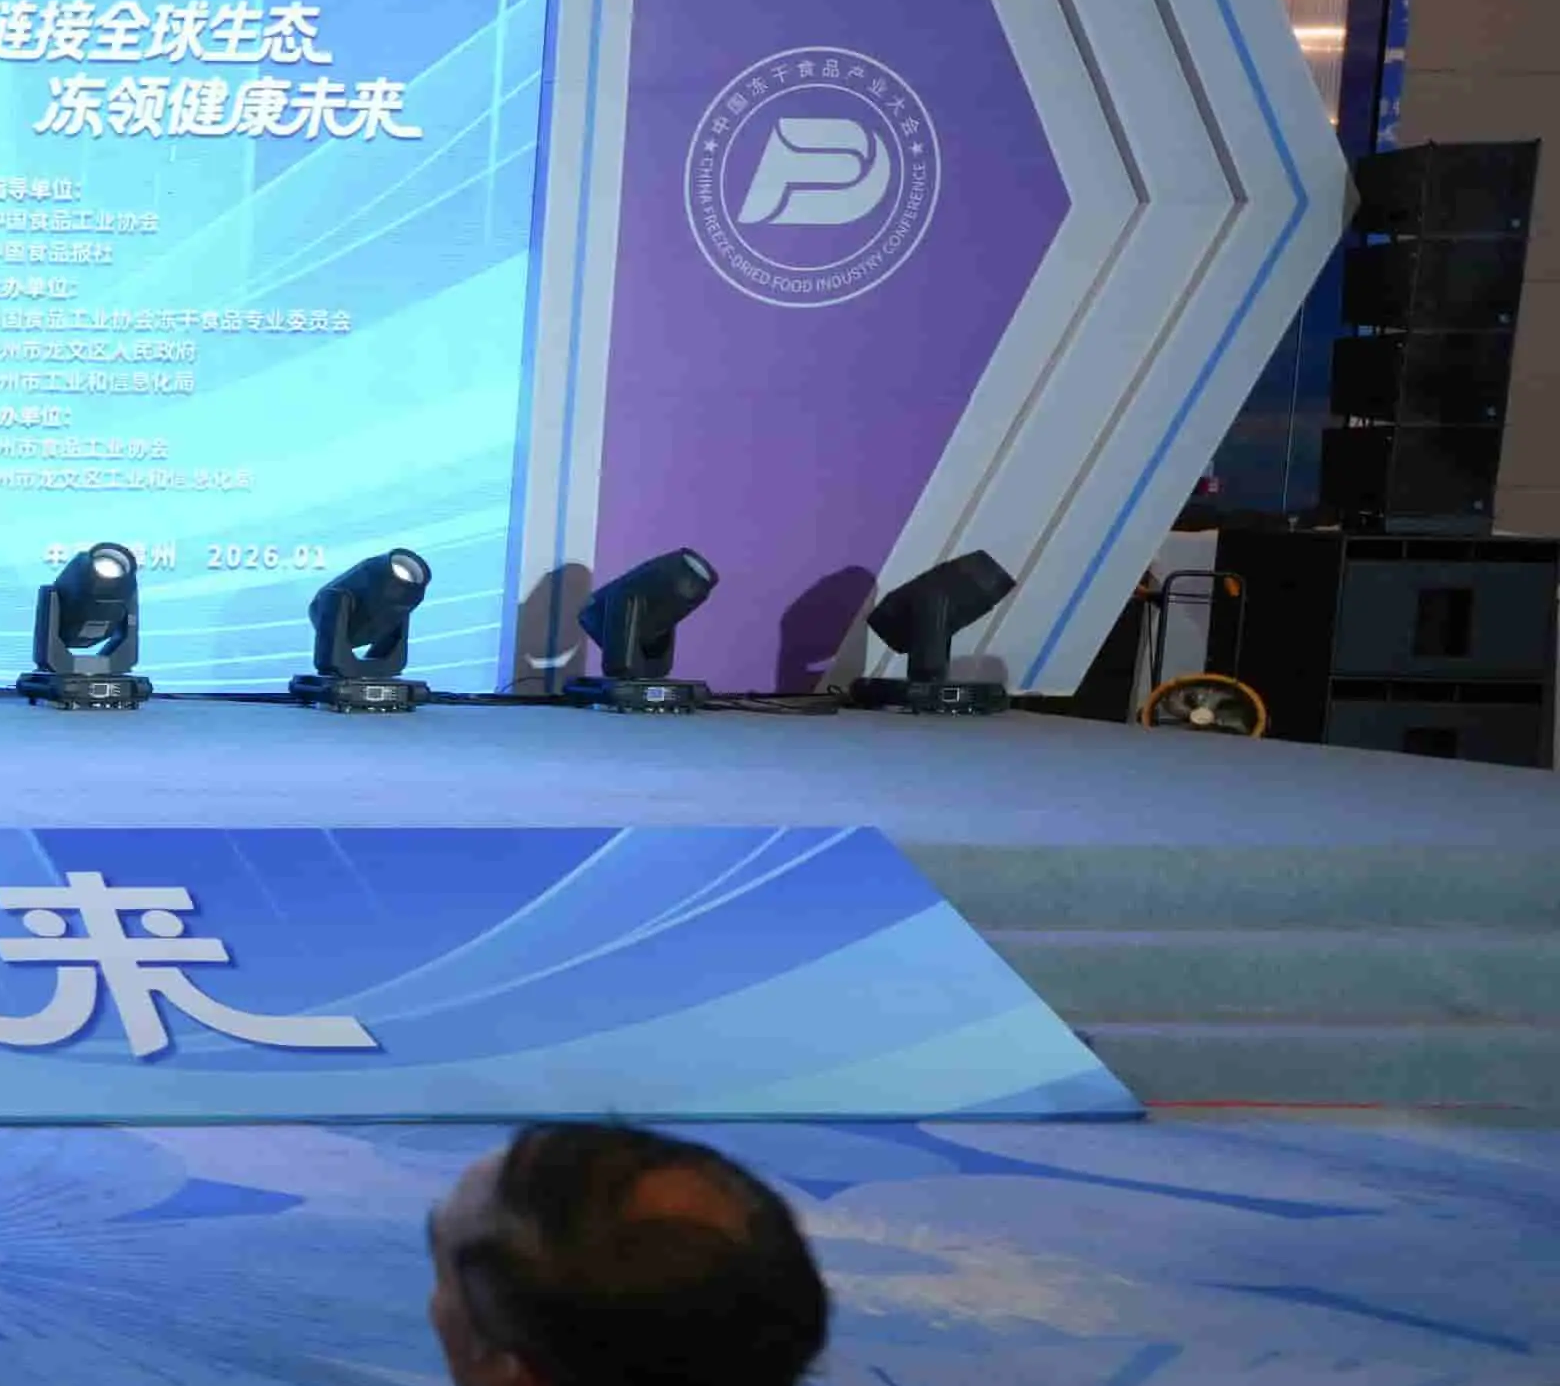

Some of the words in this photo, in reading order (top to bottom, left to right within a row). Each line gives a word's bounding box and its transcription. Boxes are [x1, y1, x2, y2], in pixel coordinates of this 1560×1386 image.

[32, 74, 424, 140] 冻领健康未来
[711, 58, 921, 137] 中国冻干食品产业大会
[206, 544, 328, 570] 2026.01
